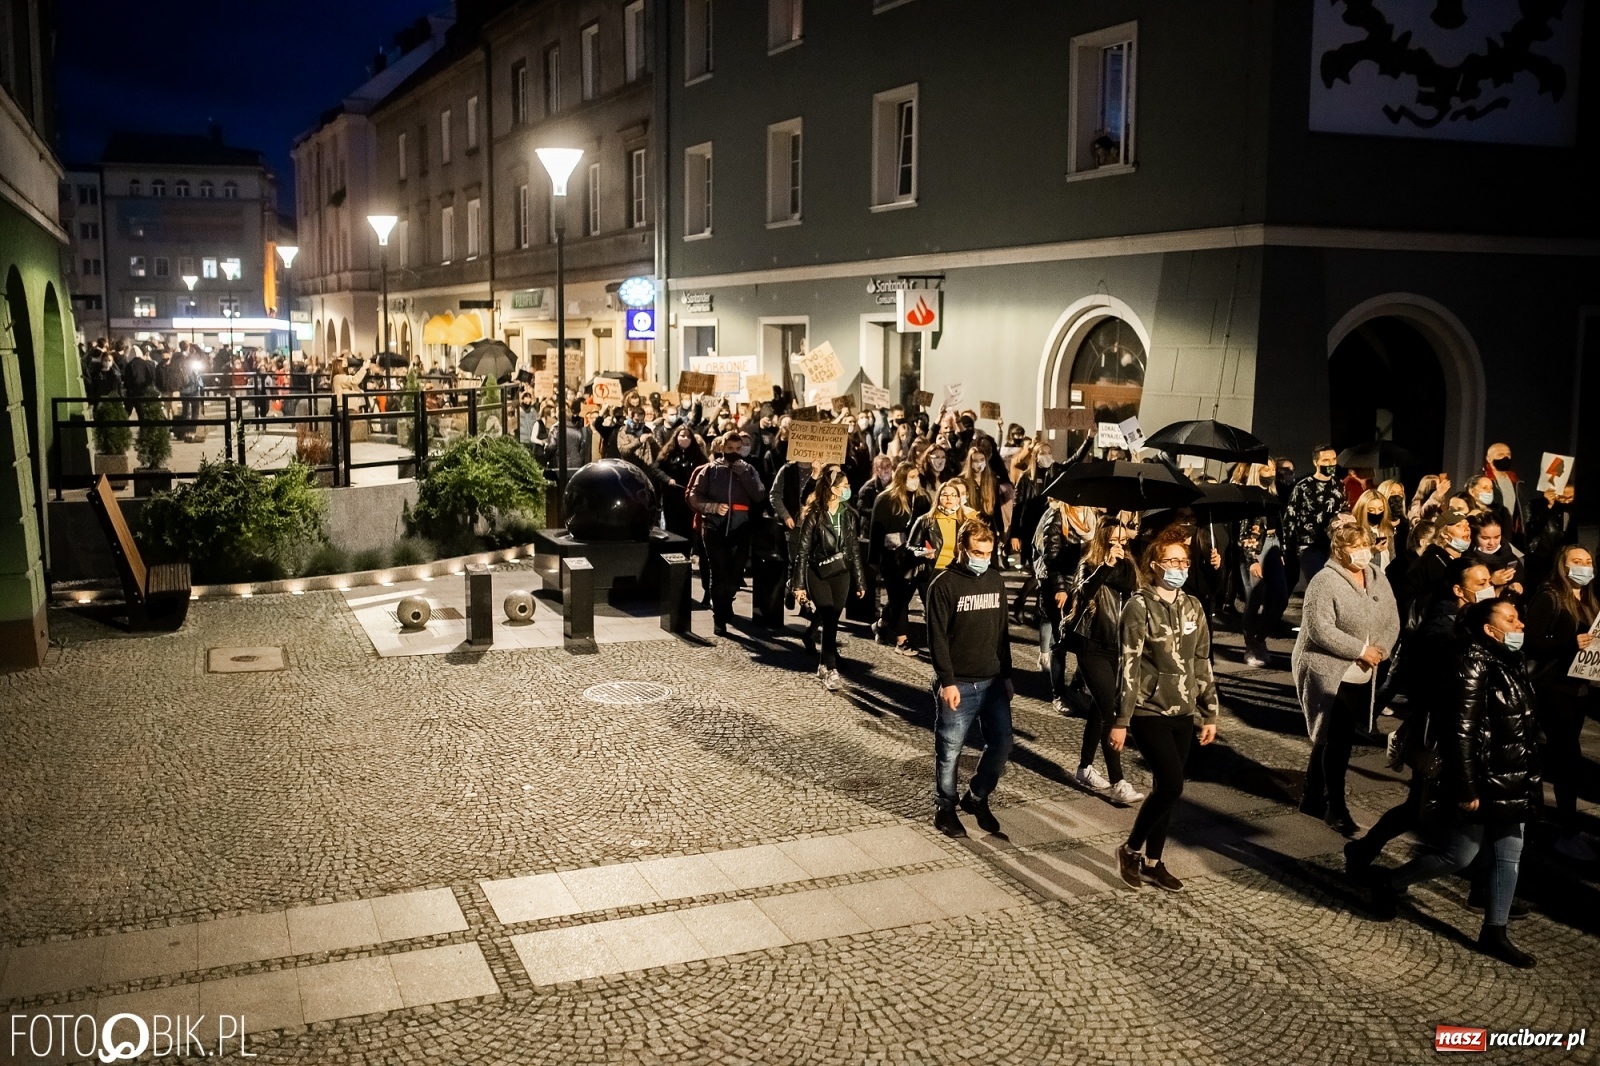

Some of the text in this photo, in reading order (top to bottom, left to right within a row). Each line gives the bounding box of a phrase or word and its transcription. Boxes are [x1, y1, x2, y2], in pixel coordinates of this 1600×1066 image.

[876, 279, 914, 293] Santandr
[876, 295, 897, 304] Consum
[706, 359, 749, 372] OBRONIE
[810, 425, 818, 433] TO
[956, 593, 1000, 612] #GYMAHOLIC
[1572, 664, 1586, 675] NIE
